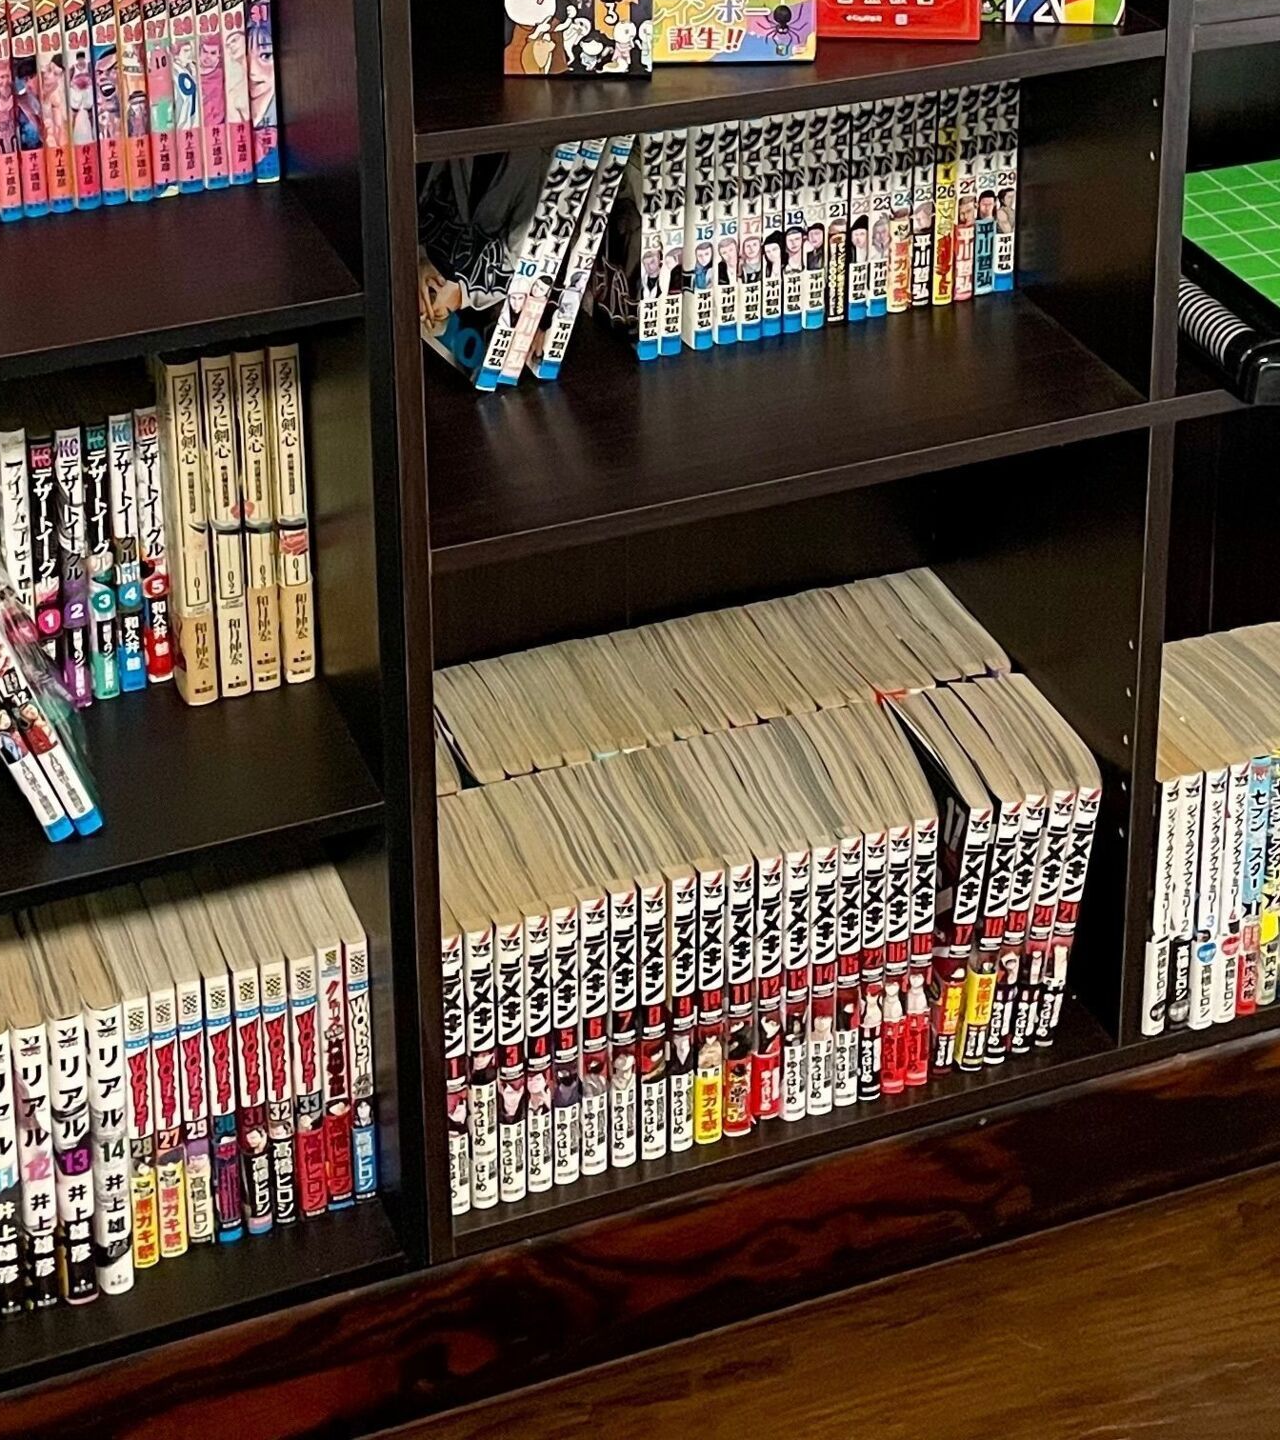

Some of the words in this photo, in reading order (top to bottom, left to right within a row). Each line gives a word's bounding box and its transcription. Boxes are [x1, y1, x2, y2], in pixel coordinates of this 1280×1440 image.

[669, 26, 744, 51] 誕生!!
[998, 172, 1016, 186] 29
[937, 184, 955, 199] 26
[874, 196, 891, 211] 23
[744, 220, 760, 234] 17
[765, 214, 781, 229] 18
[787, 210, 804, 225] 19
[696, 226, 714, 240] 15
[721, 221, 737, 236] 16
[518, 260, 537, 277] 10
[574, 255, 594, 270] 12
[244, 368, 265, 453] るろうに剣心
[279, 362, 297, 447] るろうに剣心
[177, 378, 198, 465] るろうに剣心
[211, 373, 231, 459] るろうに剣心
[124, 585, 137, 601] 4
[151, 578, 165, 594] 5
[70, 602, 84, 619] 2
[98, 592, 112, 610] 3
[44, 611, 56, 628] 1
[1061, 820, 1096, 901] デメキン
[955, 845, 989, 923] デメキン
[640, 919, 666, 1004] デメキン
[673, 912, 696, 996] デメキン
[582, 933, 609, 1018] デメキン
[611, 926, 637, 1009] デメキン
[553, 945, 580, 1029] デメキン
[499, 958, 526, 1046] デメキン
[349, 996, 372, 1078] WORST
[60, 1055, 88, 1141] リアル
[96, 1046, 124, 1129] リアル
[269, 1102, 290, 1120] 32
[299, 1095, 319, 1113] 33
[159, 1129, 180, 1150] 27
[186, 1120, 207, 1139] 29
[100, 1136, 127, 1162] 14
[62, 1149, 89, 1174] 13
